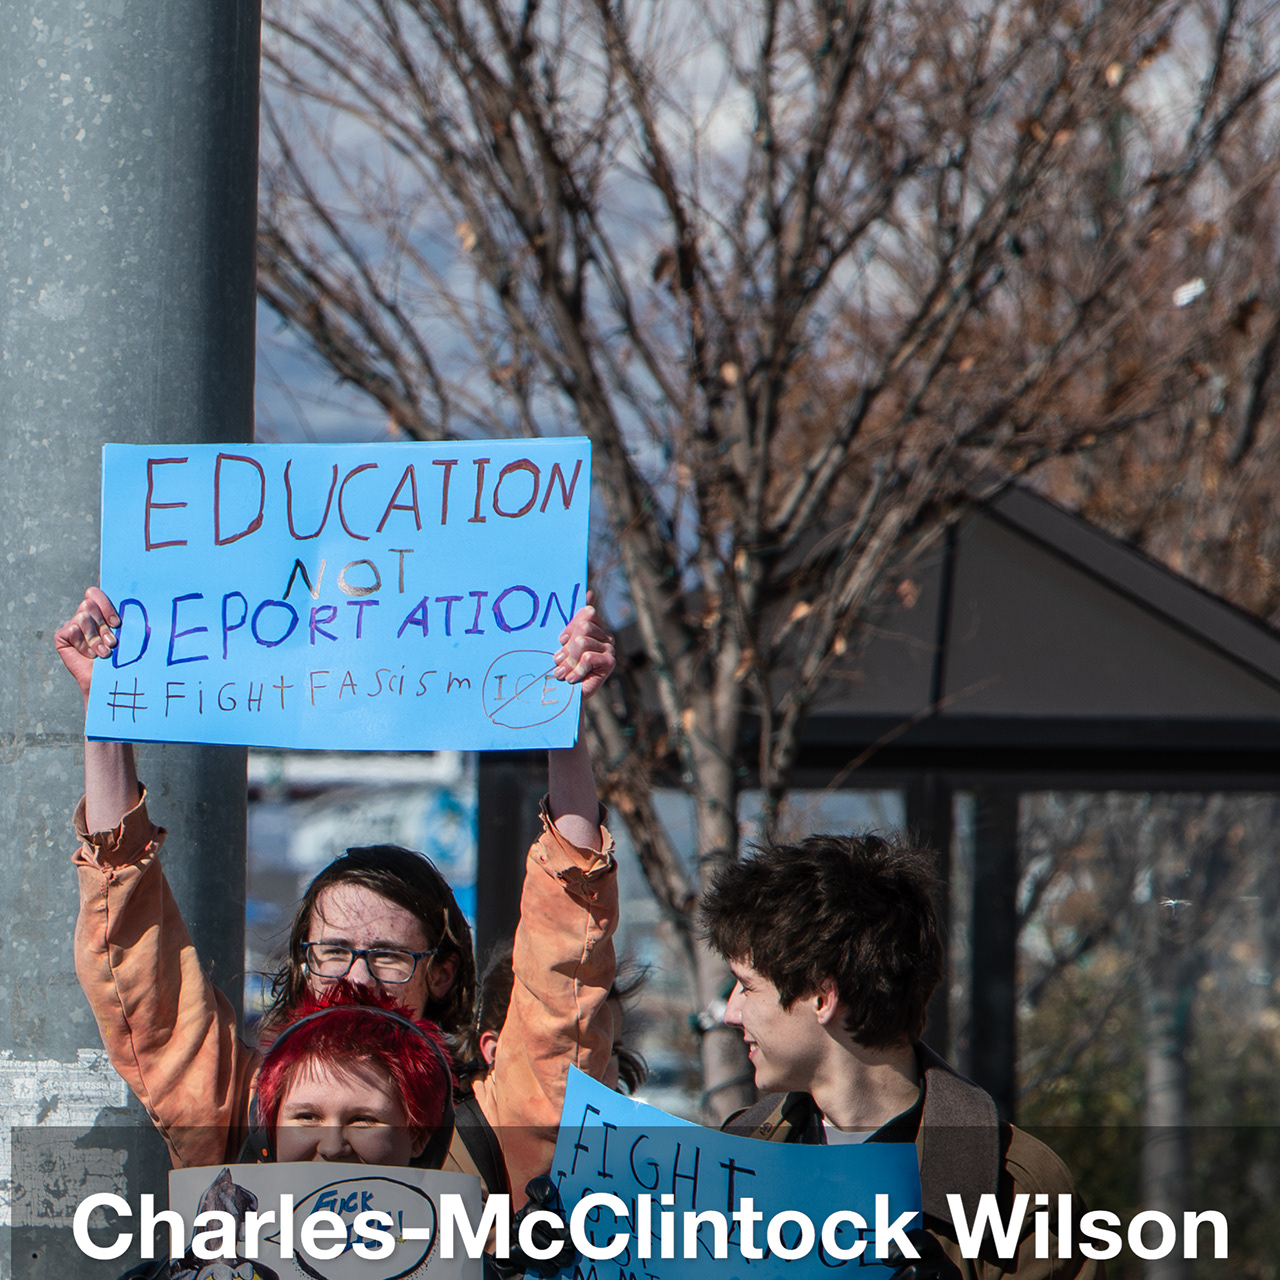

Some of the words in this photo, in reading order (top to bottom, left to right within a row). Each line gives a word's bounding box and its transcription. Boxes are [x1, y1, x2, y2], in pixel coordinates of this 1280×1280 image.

[144, 452, 584, 552] EDUCATION
[282, 547, 416, 601] NOT
[111, 581, 581, 670] DEPORTATION
[492, 673, 560, 707] ICE
[570, 1103, 758, 1214] FIGHT
